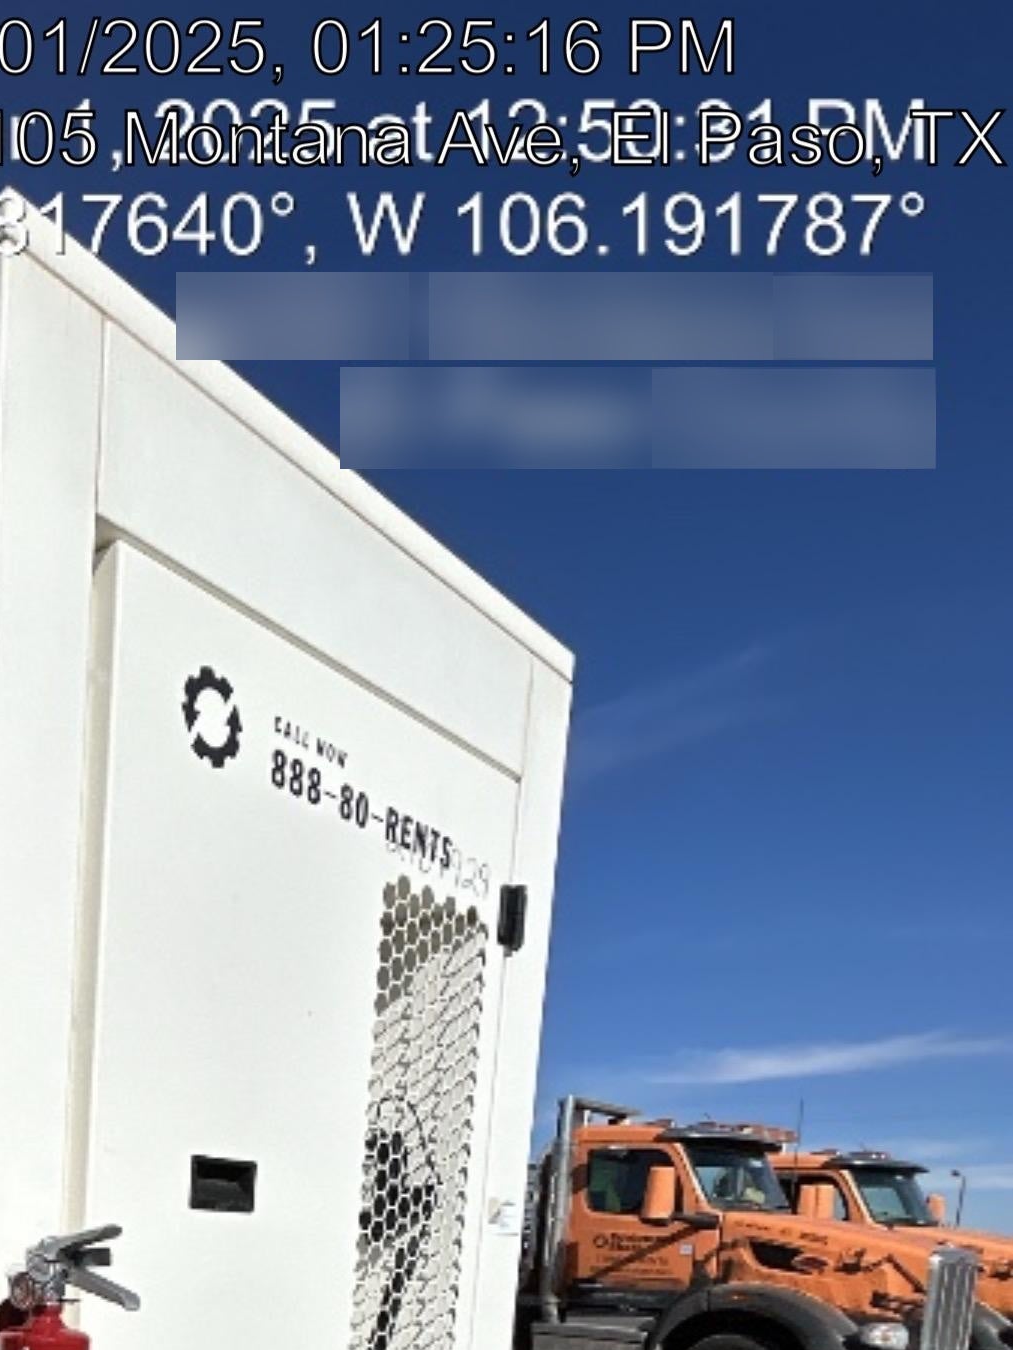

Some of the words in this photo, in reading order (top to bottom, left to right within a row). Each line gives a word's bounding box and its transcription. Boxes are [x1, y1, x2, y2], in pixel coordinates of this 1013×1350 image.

[274, 716, 309, 750] CALL
[316, 737, 349, 769] NOW
[271, 749, 453, 869] 888-80-RENTS
